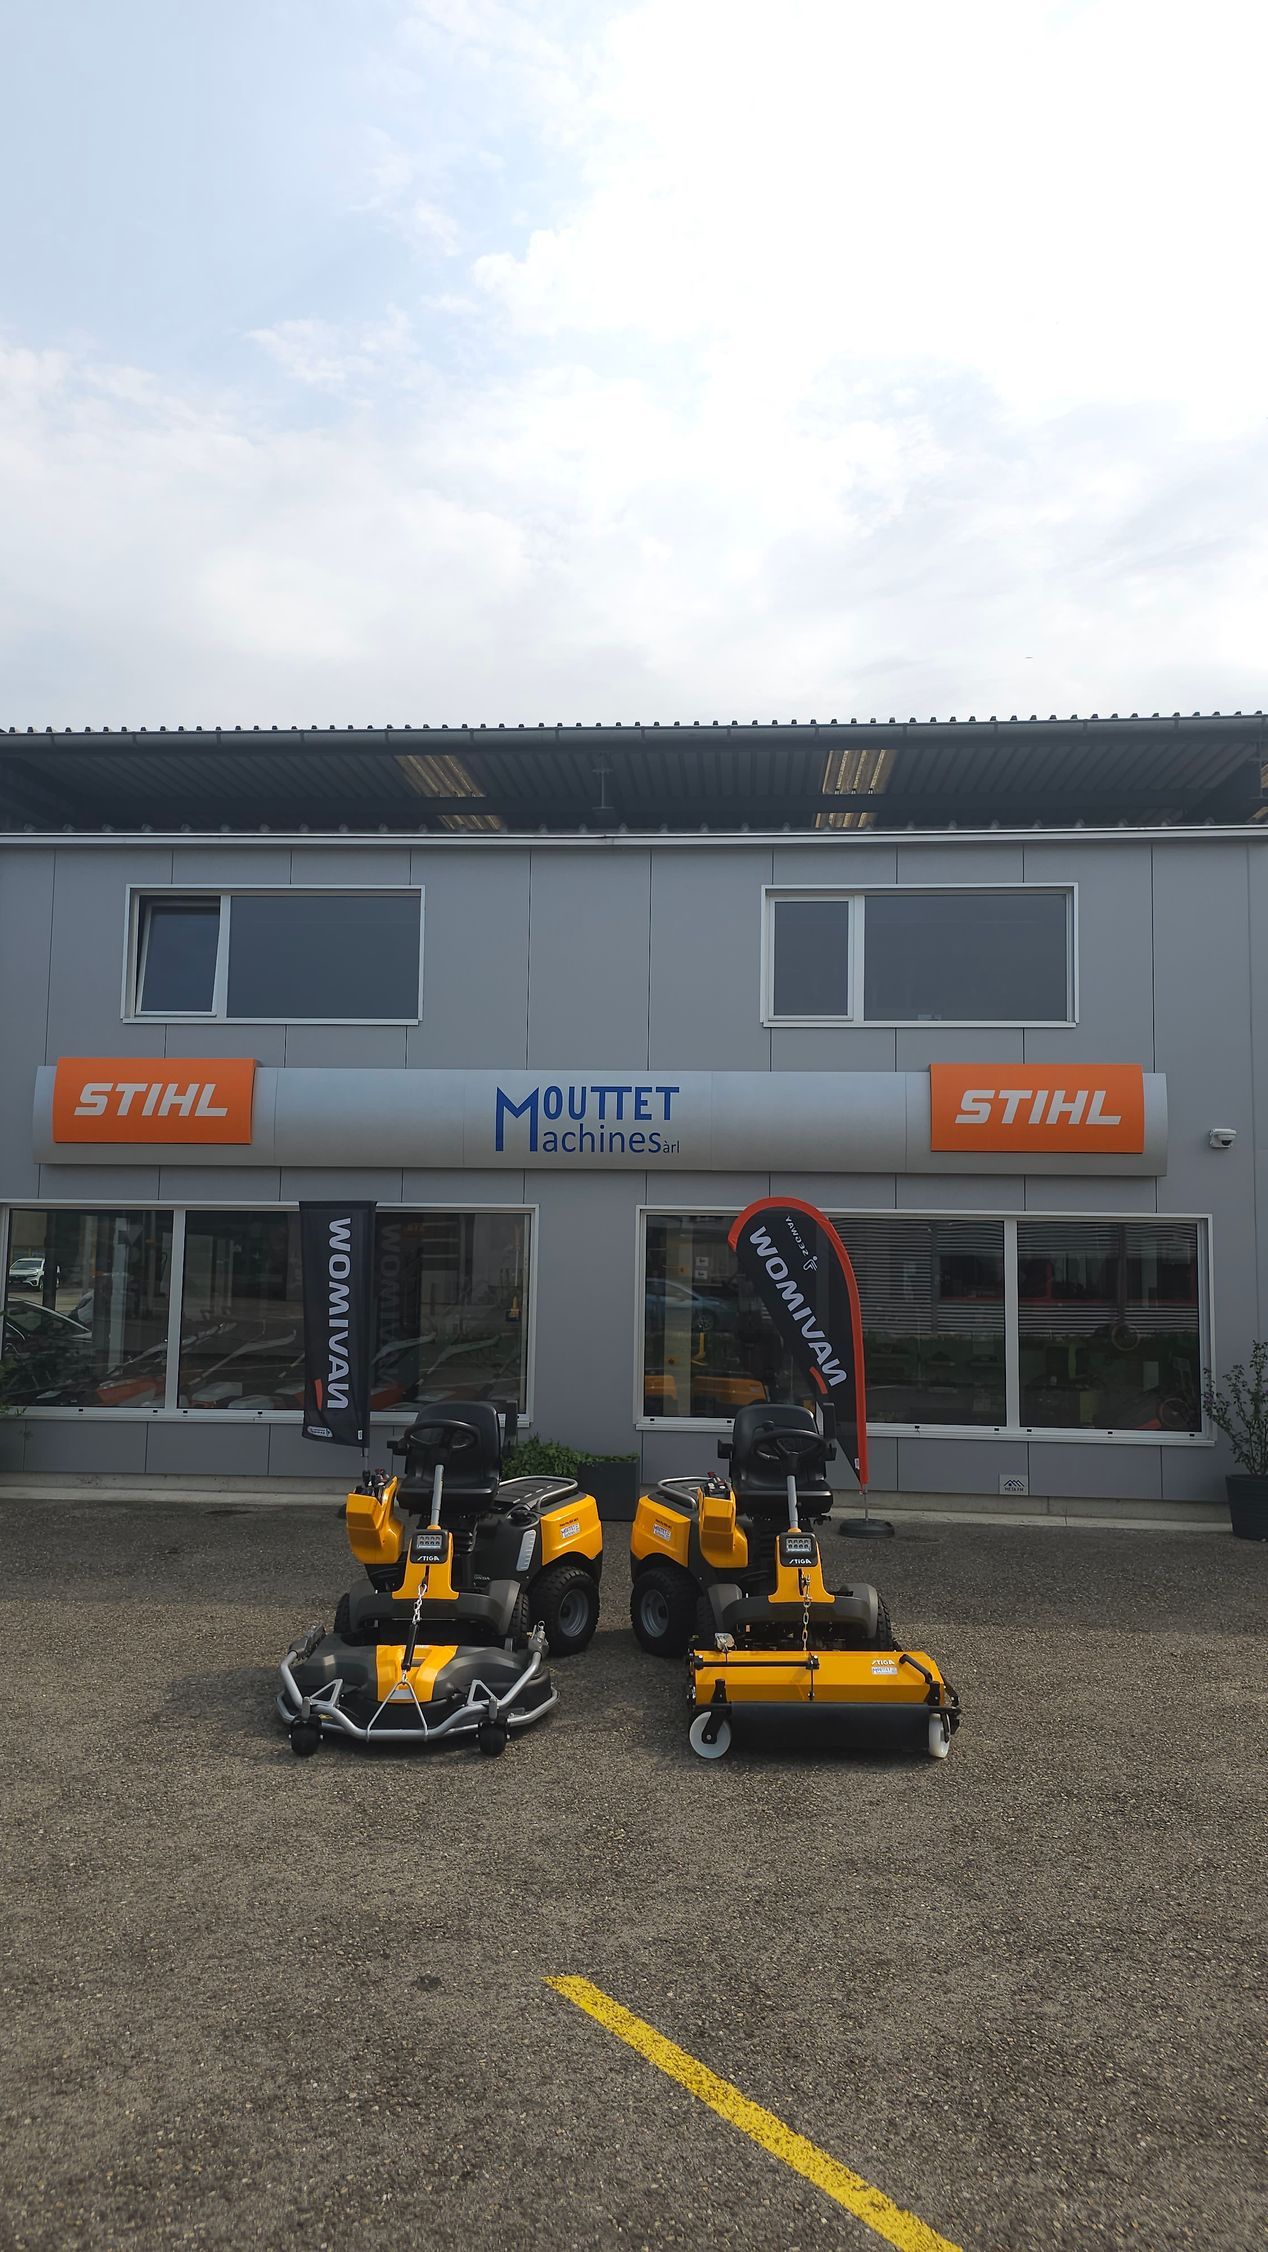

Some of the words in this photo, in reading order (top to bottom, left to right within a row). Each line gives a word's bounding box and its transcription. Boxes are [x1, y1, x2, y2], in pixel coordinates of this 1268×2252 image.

[73, 1082, 229, 1117] STIHL
[495, 1085, 680, 1152] MOUTTET
[954, 1088, 1123, 1126] STIHL
